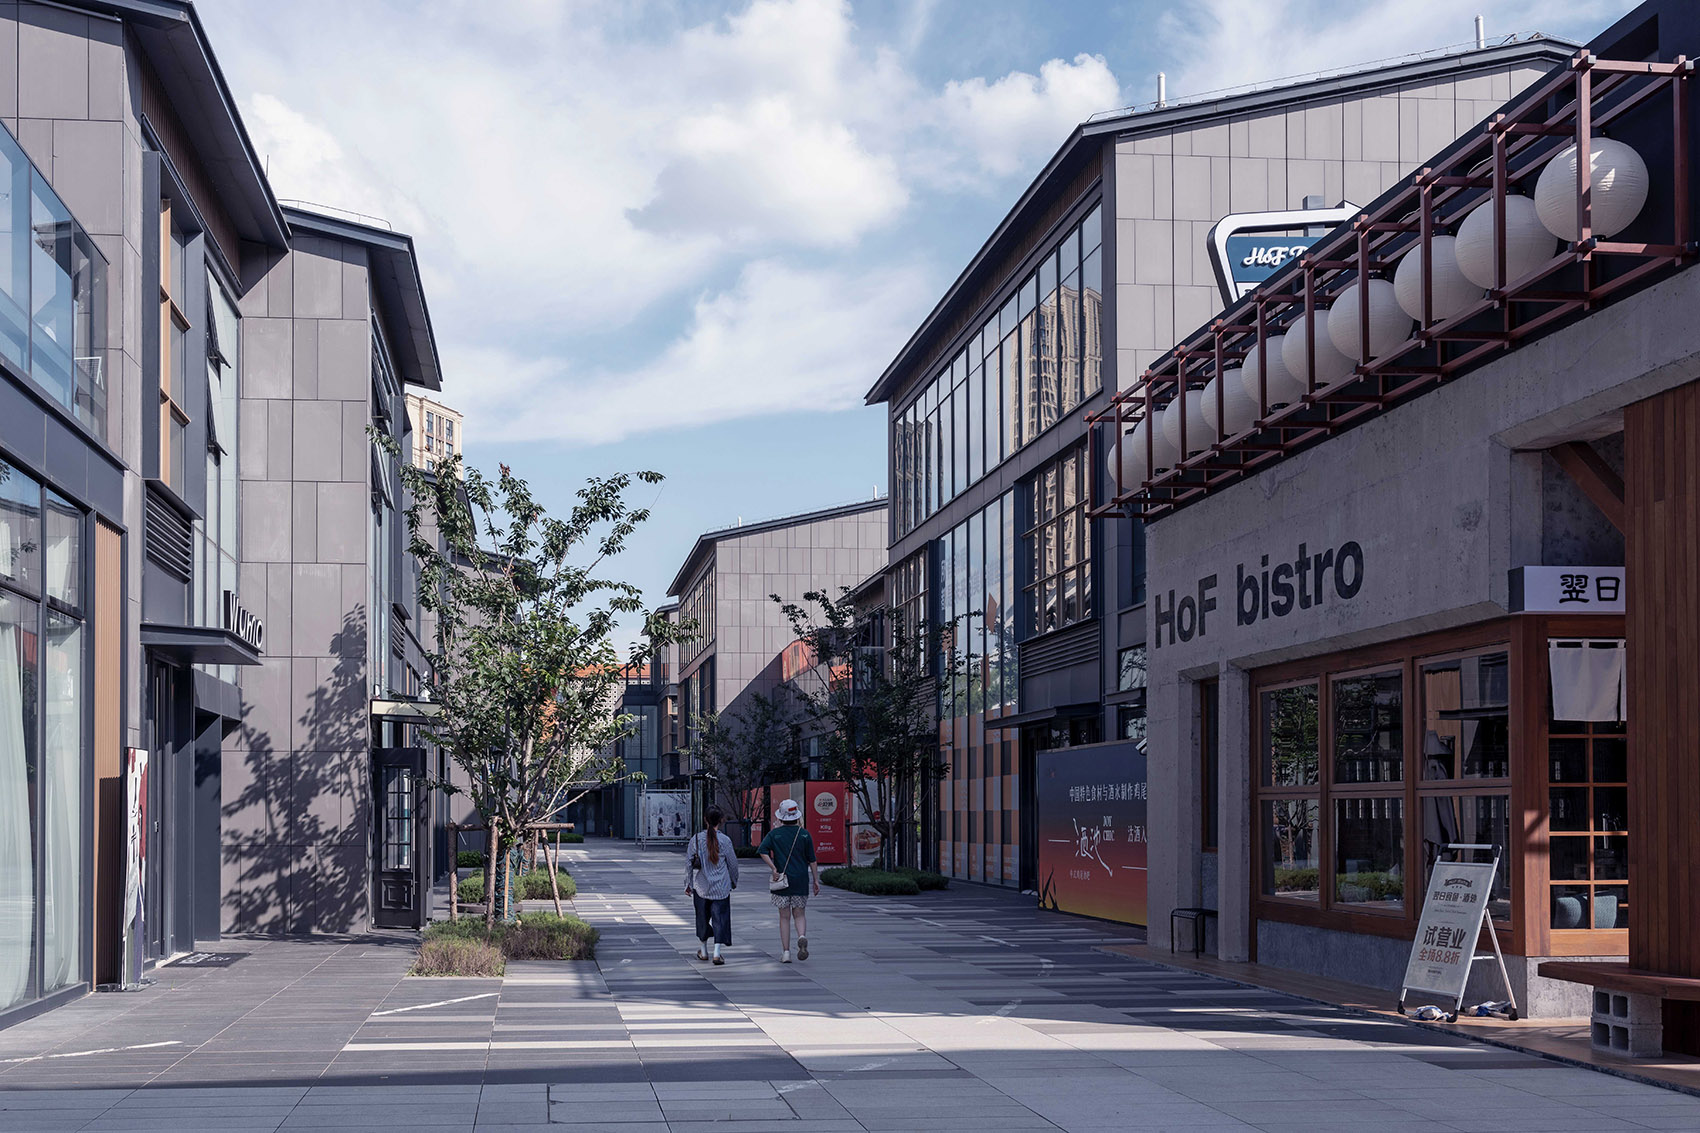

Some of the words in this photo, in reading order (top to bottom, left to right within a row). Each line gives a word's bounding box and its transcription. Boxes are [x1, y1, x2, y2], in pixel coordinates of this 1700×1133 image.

[1155, 574, 1217, 649] HoF
[1237, 541, 1364, 626] bistro
[1558, 573, 1621, 604] 翌日
[1423, 925, 1467, 949] 试营业
[1418, 947, 1461, 965] 全场8.8折
